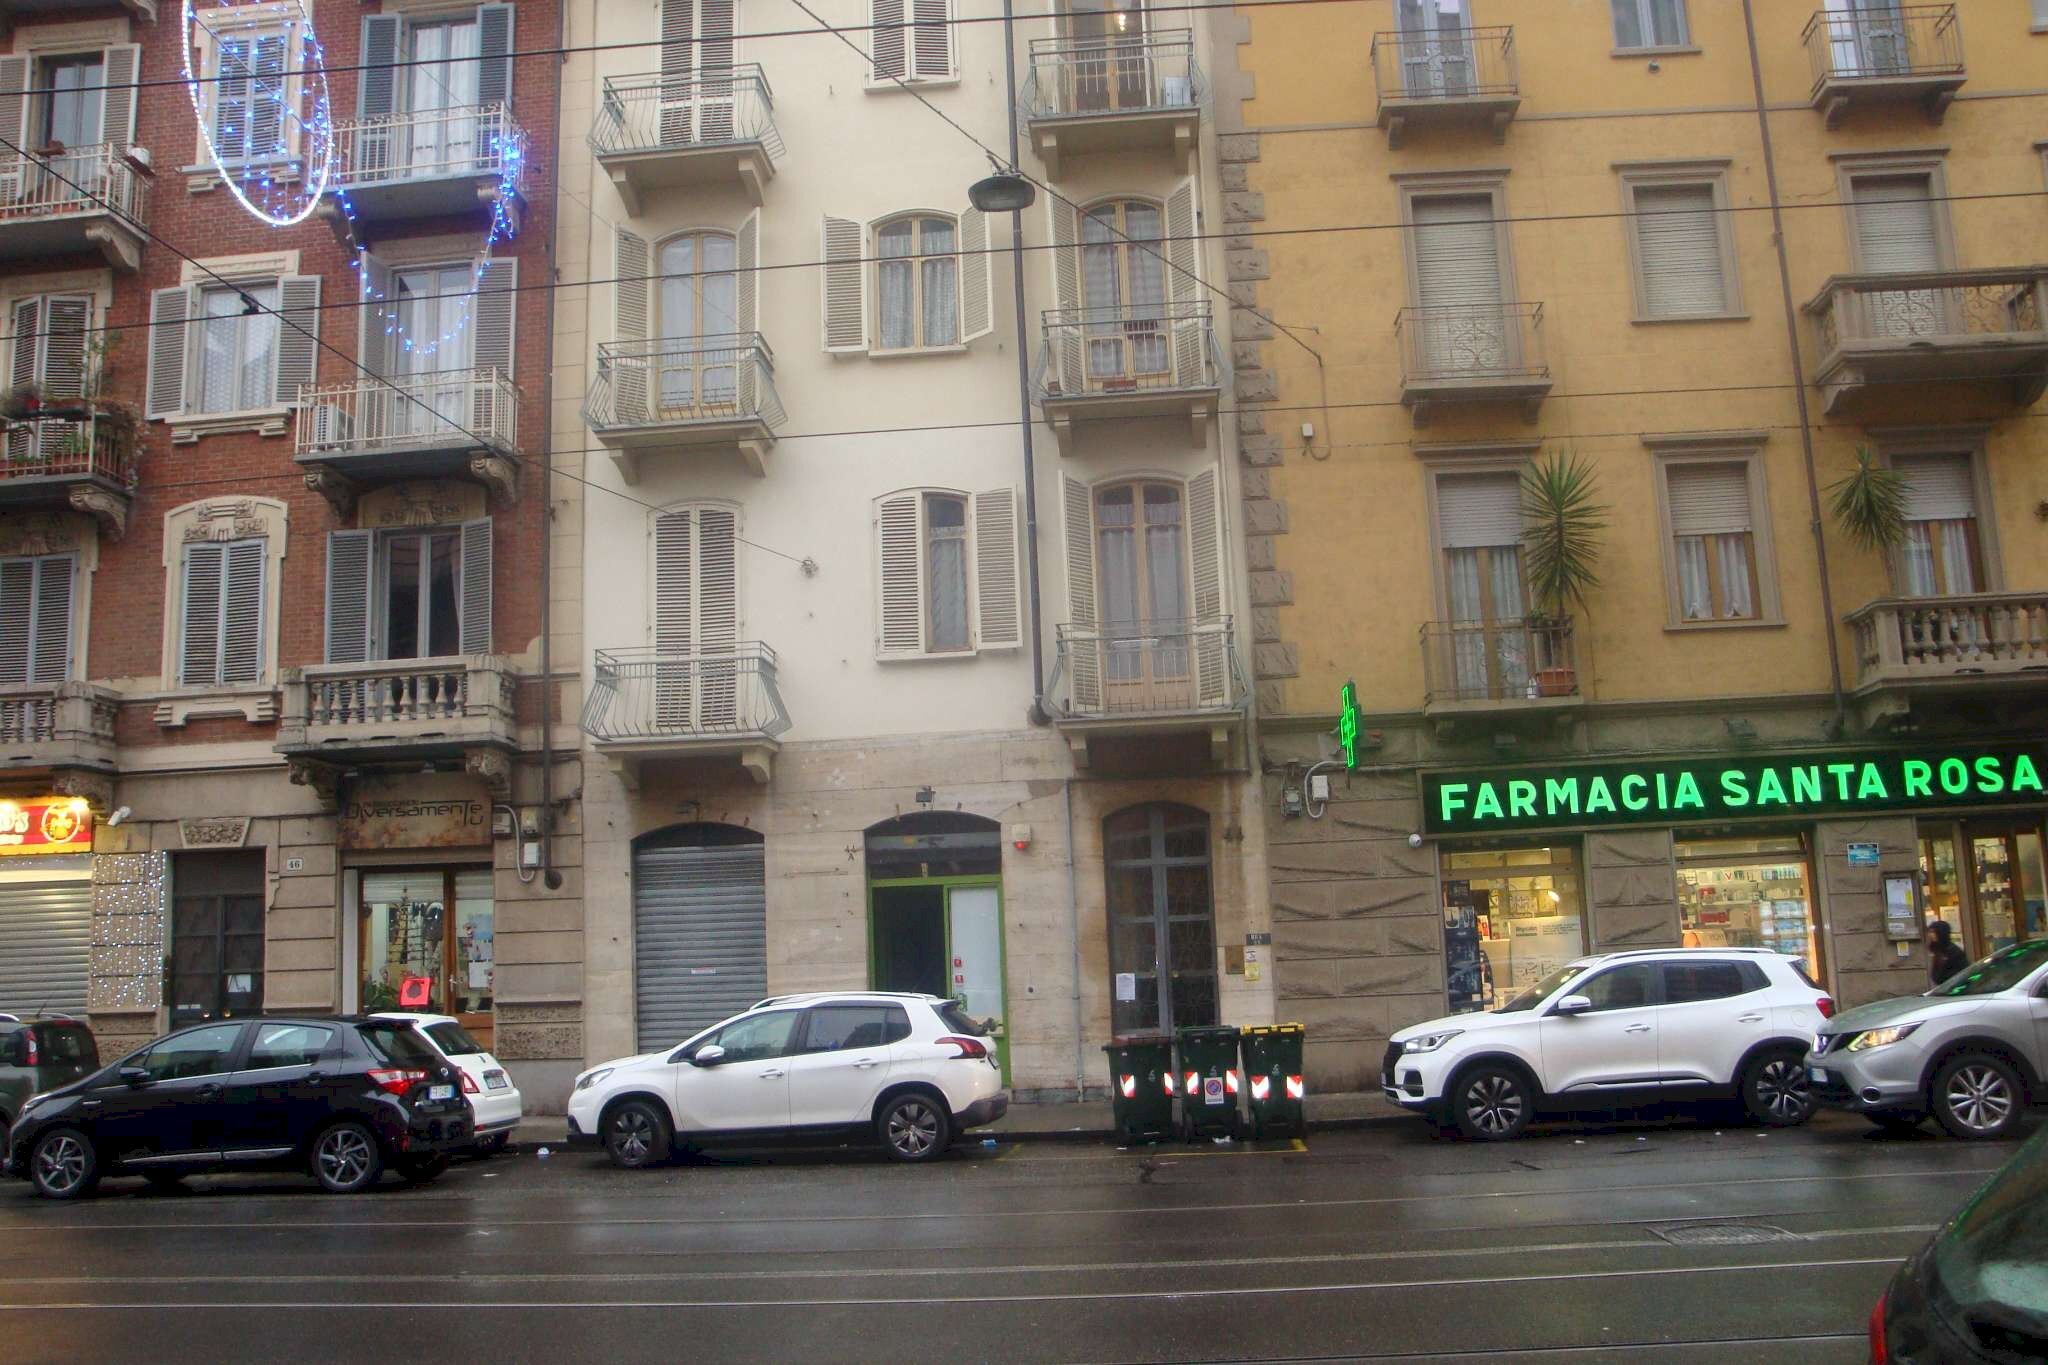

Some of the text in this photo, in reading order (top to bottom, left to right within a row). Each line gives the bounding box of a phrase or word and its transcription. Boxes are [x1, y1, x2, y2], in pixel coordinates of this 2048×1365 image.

[1440, 754, 2043, 821] FARMACIA SANTA ROSA
